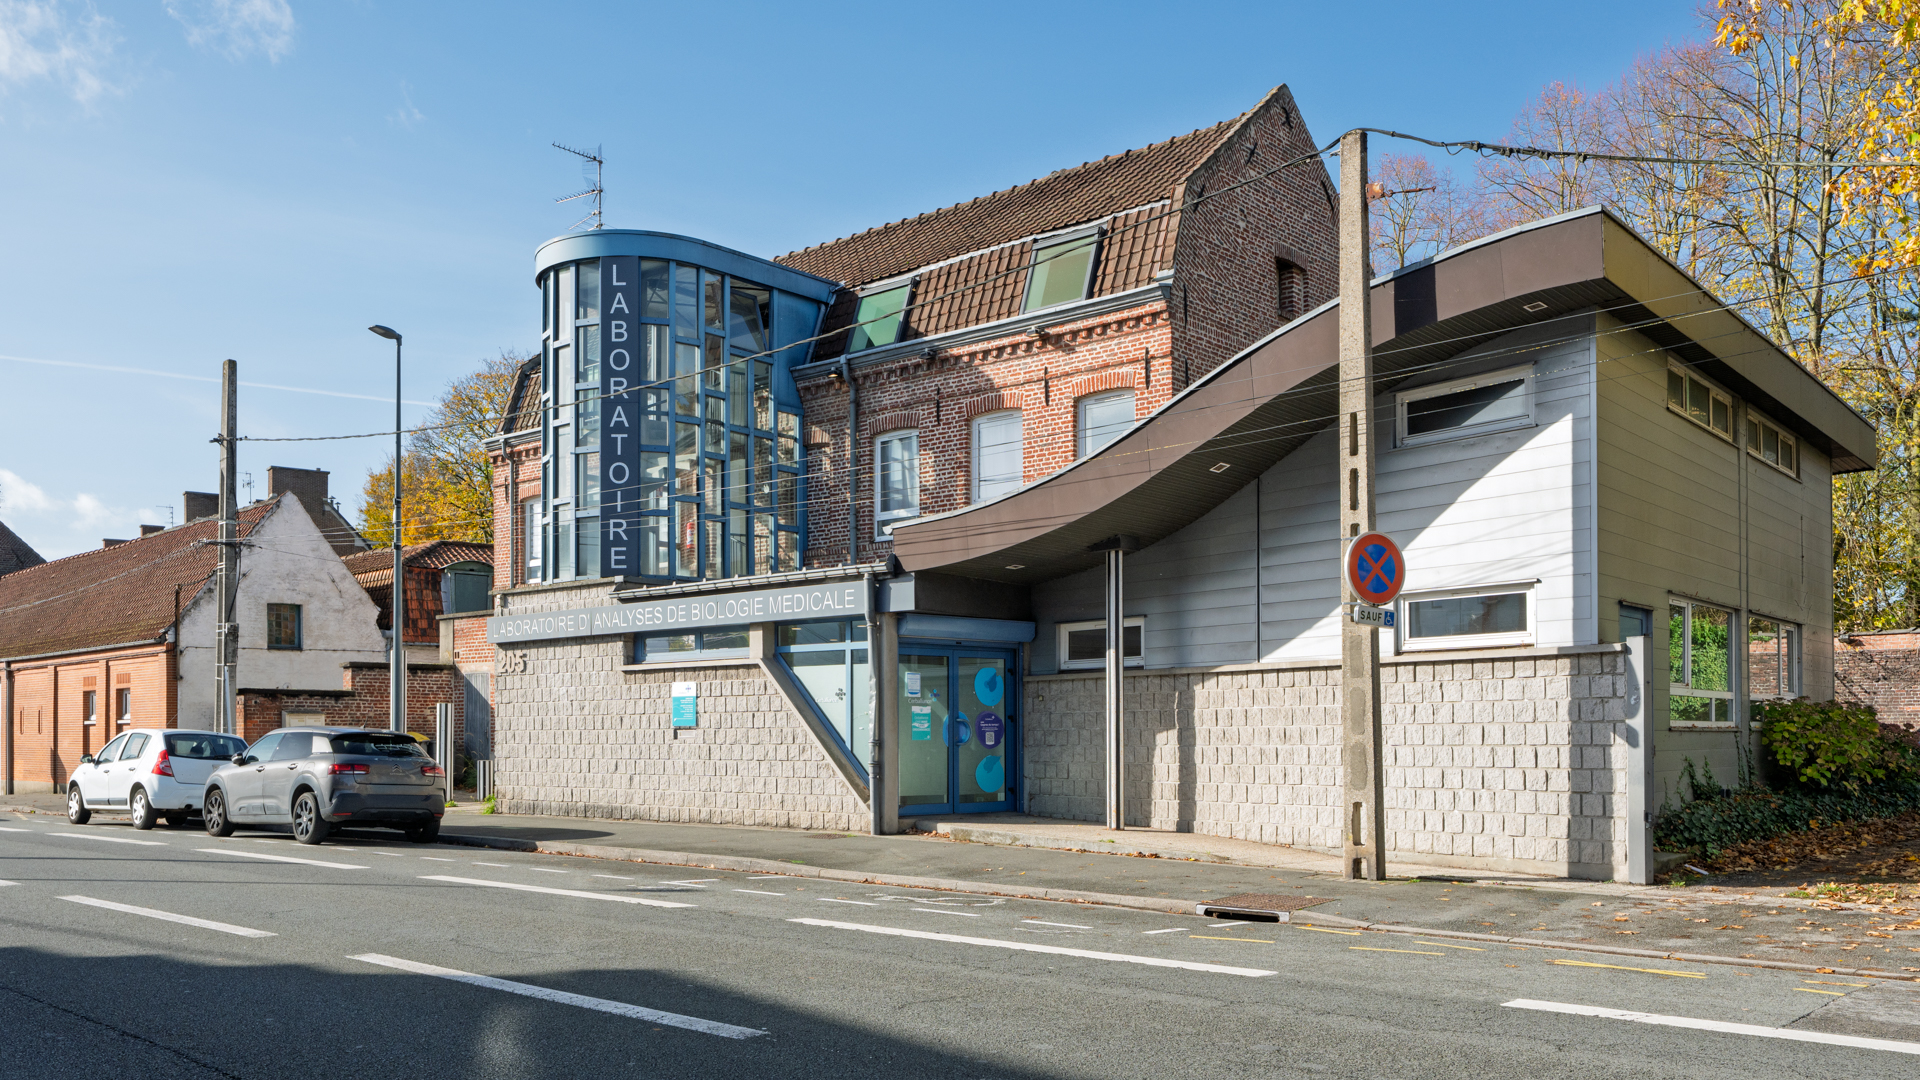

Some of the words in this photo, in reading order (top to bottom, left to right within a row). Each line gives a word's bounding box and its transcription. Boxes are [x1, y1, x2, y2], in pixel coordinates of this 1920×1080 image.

[609, 264, 630, 569] LABORATOIRE
[493, 615, 575, 638] LABORATOIRE
[667, 604, 687, 623] DE
[691, 597, 764, 621] BIOLOGIE
[769, 589, 855, 615] MEDICALE
[1360, 610, 1383, 622] SAUF
[498, 651, 525, 674] 205
